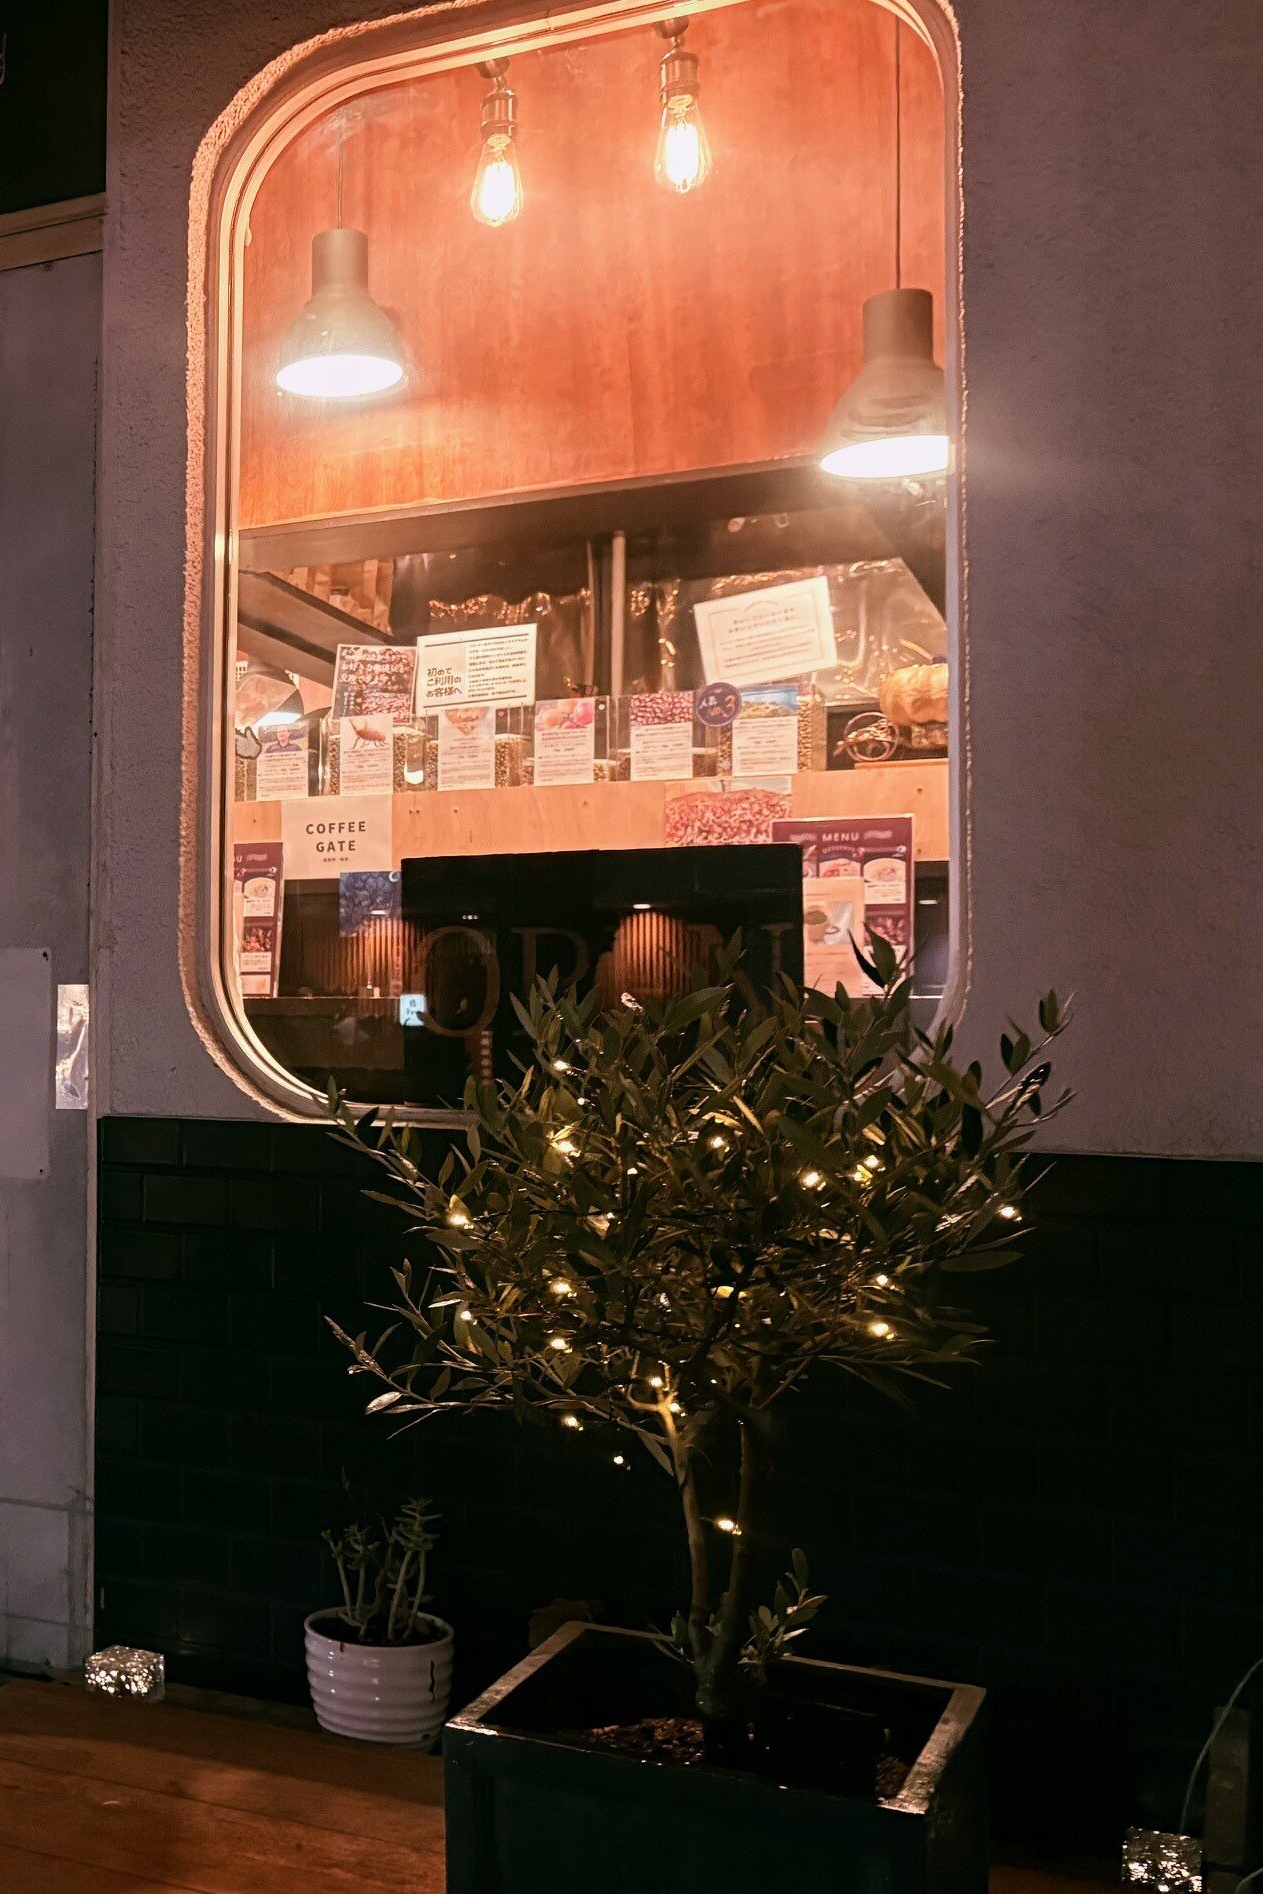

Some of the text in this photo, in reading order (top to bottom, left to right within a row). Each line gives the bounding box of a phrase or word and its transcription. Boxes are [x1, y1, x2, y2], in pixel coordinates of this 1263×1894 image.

[427, 667, 452, 677] 初めて
[426, 675, 461, 687] ご利用の
[426, 686, 462, 698] お客様へ
[305, 821, 367, 835] COFFEE
[821, 831, 860, 842] MENU
[316, 840, 357, 853] GATE
